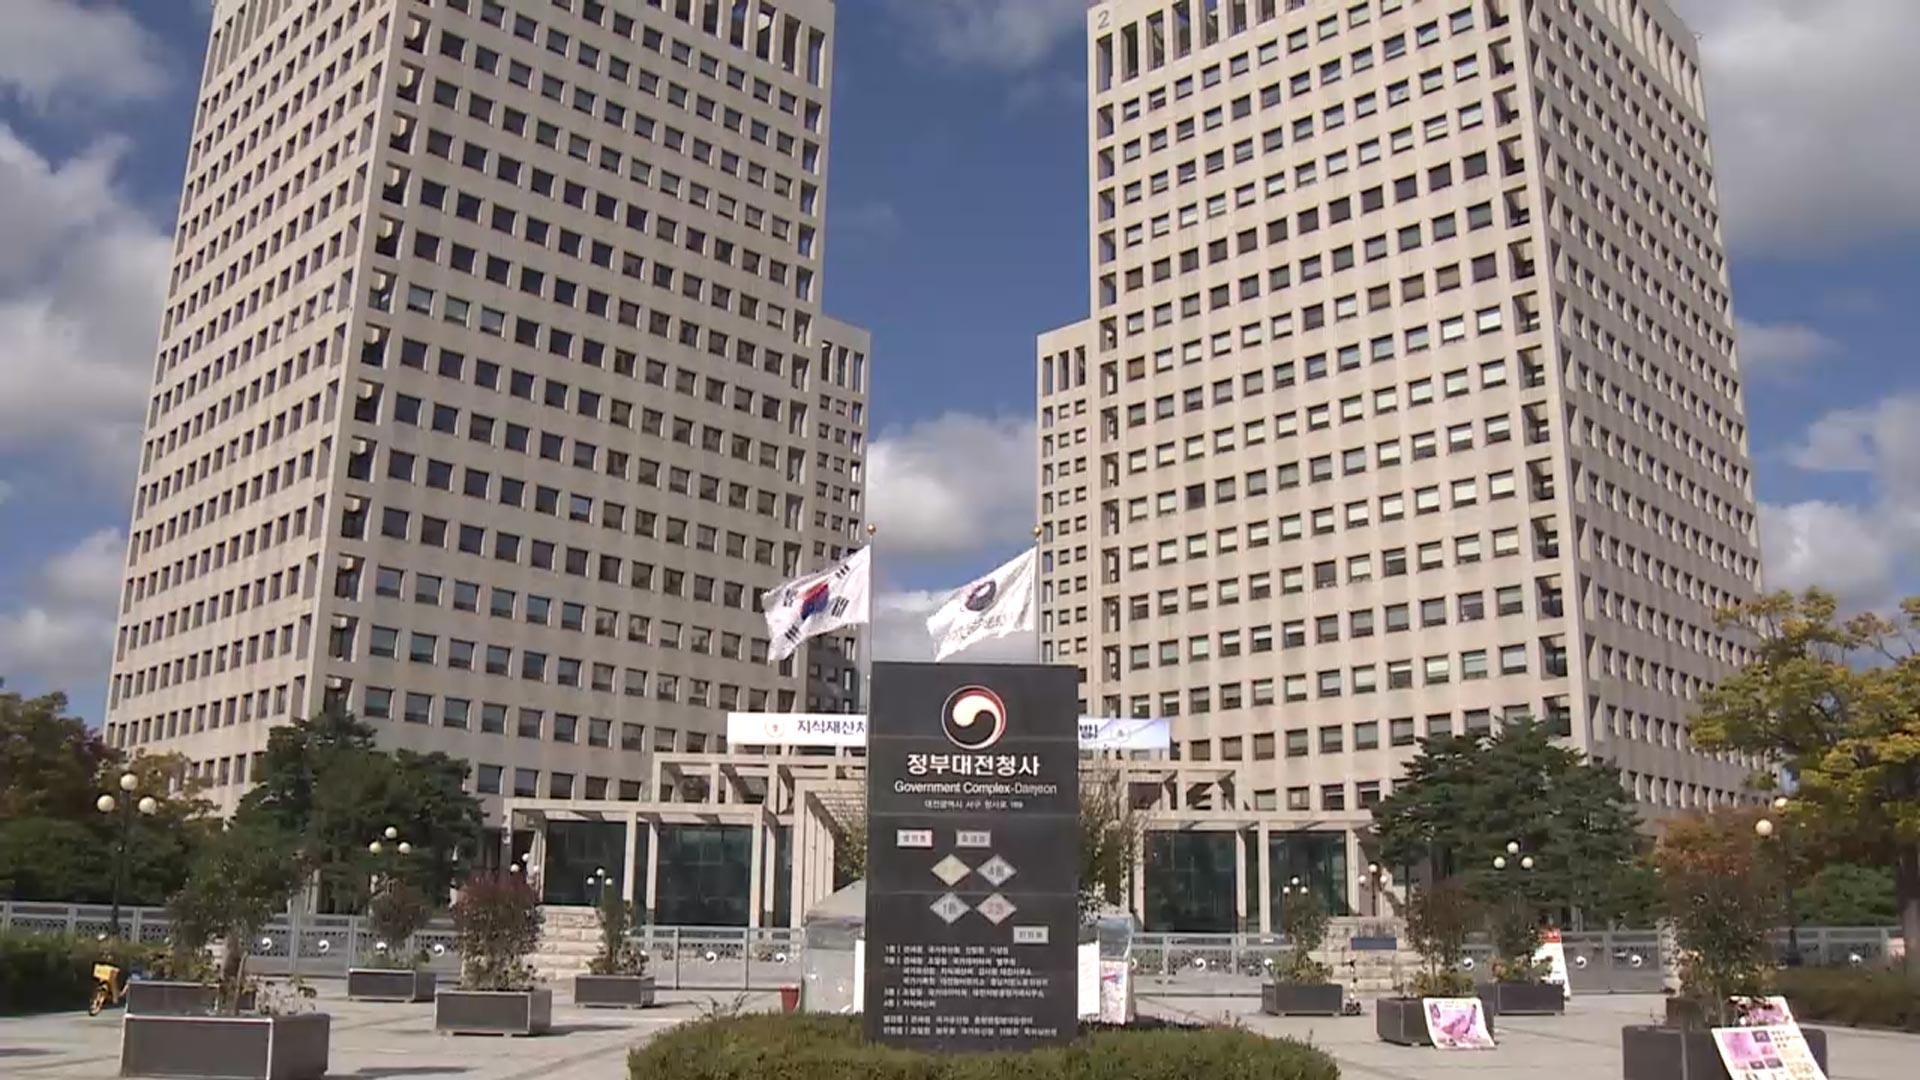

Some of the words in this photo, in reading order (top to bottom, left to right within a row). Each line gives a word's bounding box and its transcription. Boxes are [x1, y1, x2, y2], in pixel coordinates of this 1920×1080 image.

[1098, 10, 1110, 29] 2
[906, 753, 1041, 777] 정부대전청사
[894, 780, 961, 795] Government
